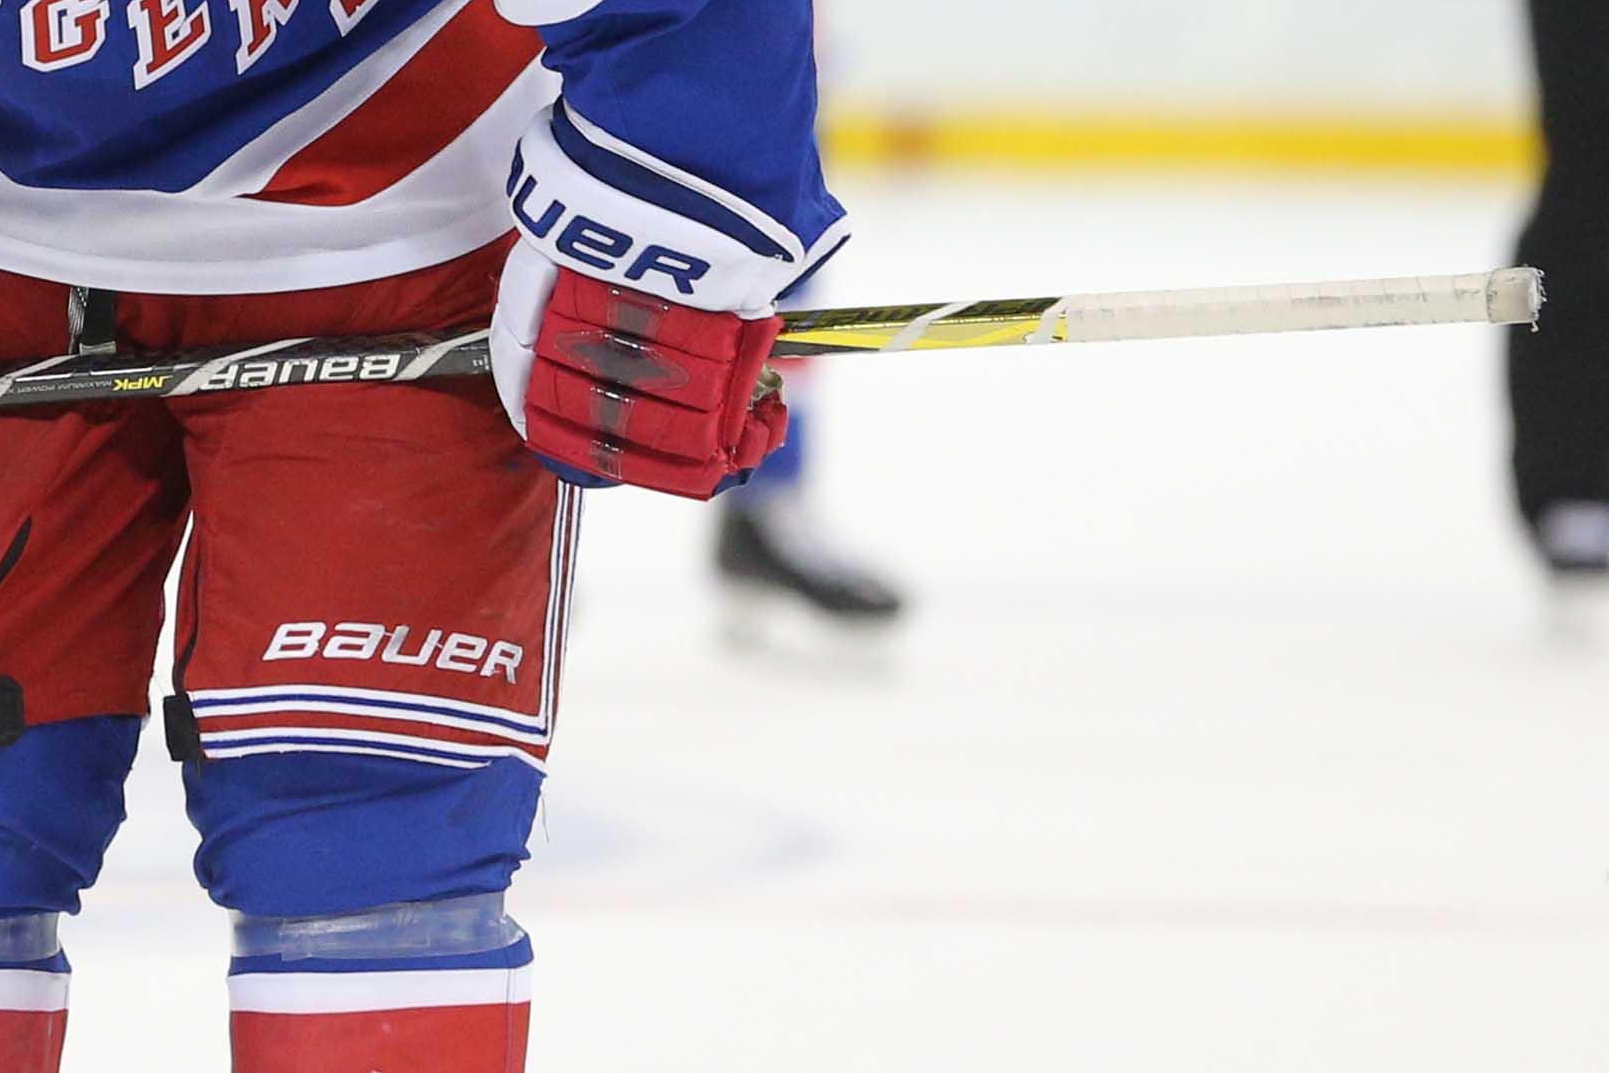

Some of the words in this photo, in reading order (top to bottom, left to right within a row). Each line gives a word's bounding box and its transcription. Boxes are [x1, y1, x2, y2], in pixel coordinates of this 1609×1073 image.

[113, 375, 168, 391] MPK
[199, 353, 401, 391] BAUER
[261, 621, 525, 684] BAUER
